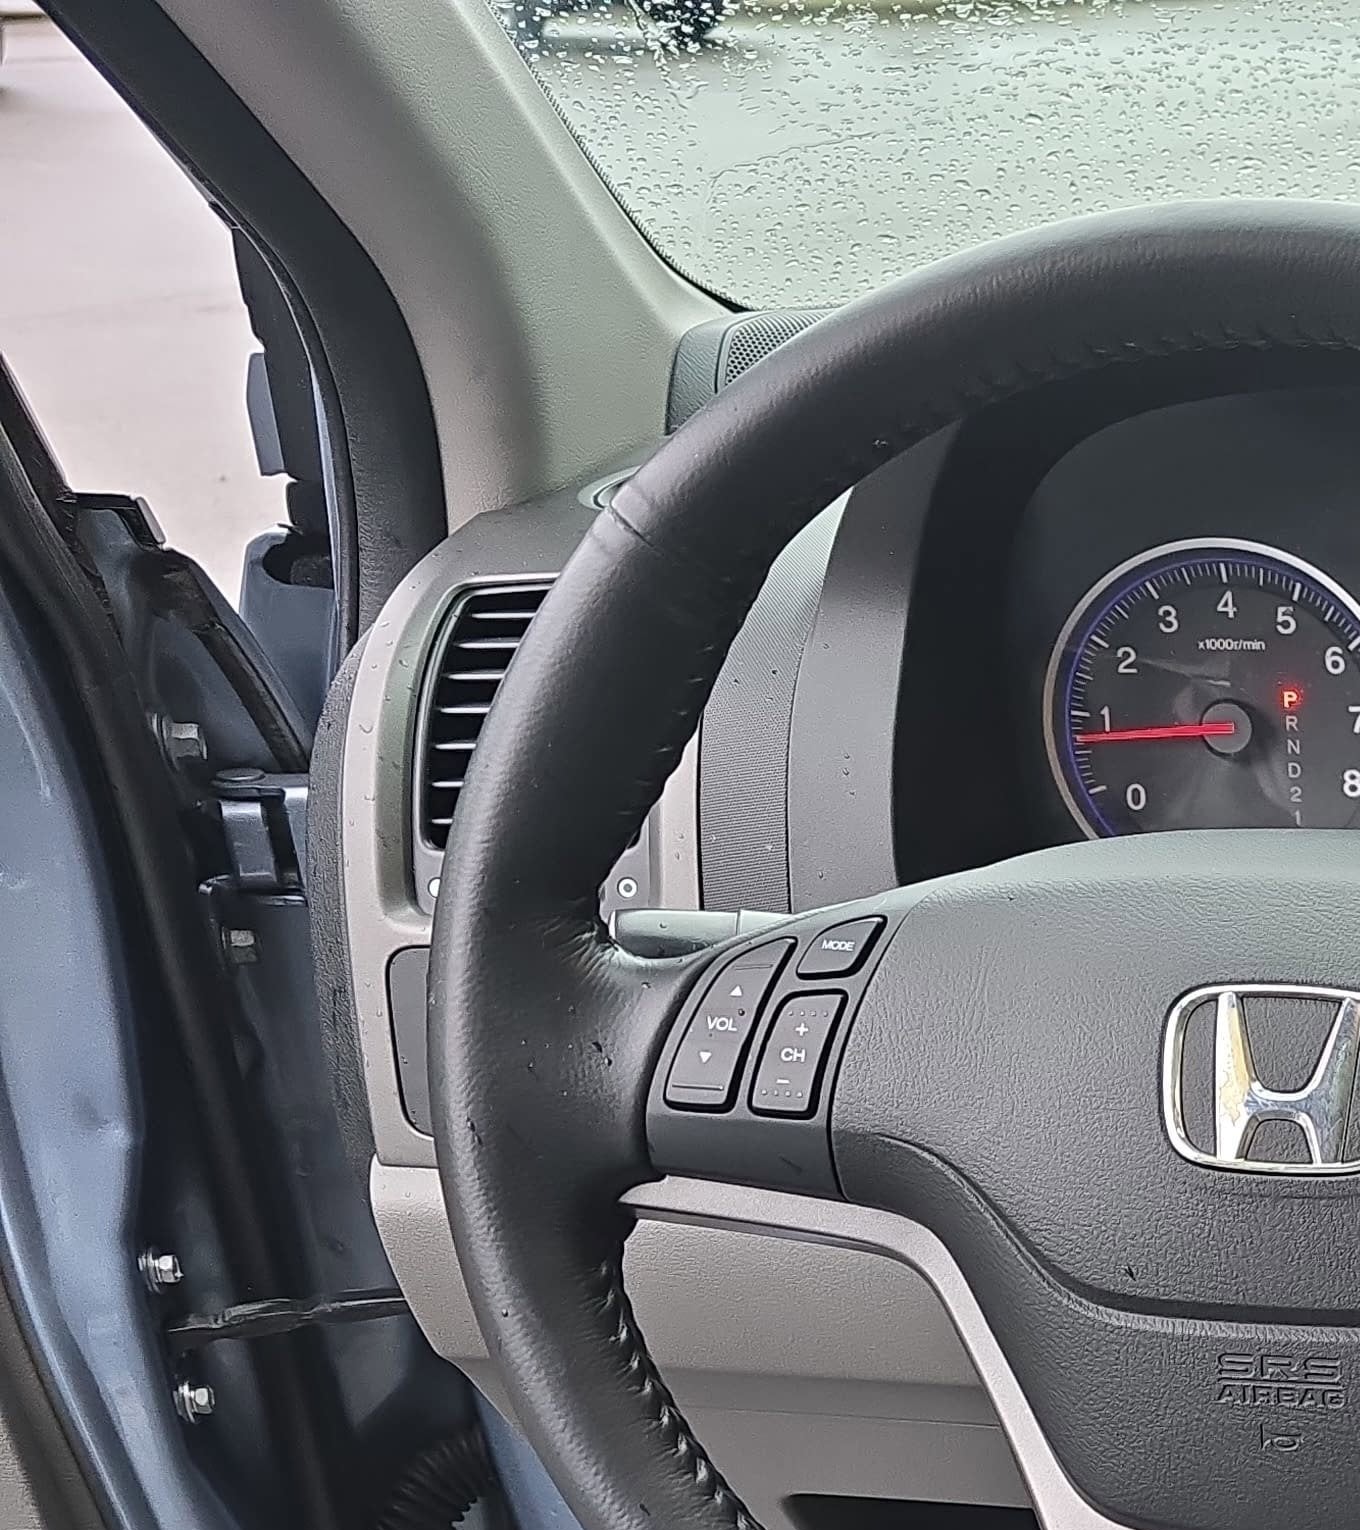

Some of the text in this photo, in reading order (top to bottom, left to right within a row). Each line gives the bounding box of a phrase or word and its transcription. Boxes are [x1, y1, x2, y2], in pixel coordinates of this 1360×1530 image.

[1216, 590, 1237, 618] 4
[1158, 605, 1179, 633] 3
[1275, 605, 1297, 635] 5
[1198, 638, 1266, 652] x1000r/min
[1116, 646, 1137, 674] 2
[1324, 646, 1345, 675] 6
[1283, 691, 1298, 708] P
[1100, 706, 1111, 733] 1
[1285, 716, 1299, 731] R
[1287, 740, 1301, 755] N
[1288, 763, 1302, 779] D
[1126, 783, 1146, 811] 0
[1290, 787, 1303, 803] 2
[1294, 809, 1302, 825] 1
[821, 939, 855, 952] MODE
[706, 1016, 738, 1032] VOL
[780, 1047, 806, 1062] CH
[1217, 1352, 1342, 1382] SRS
[1214, 1384, 1346, 1409] AIRBAG
